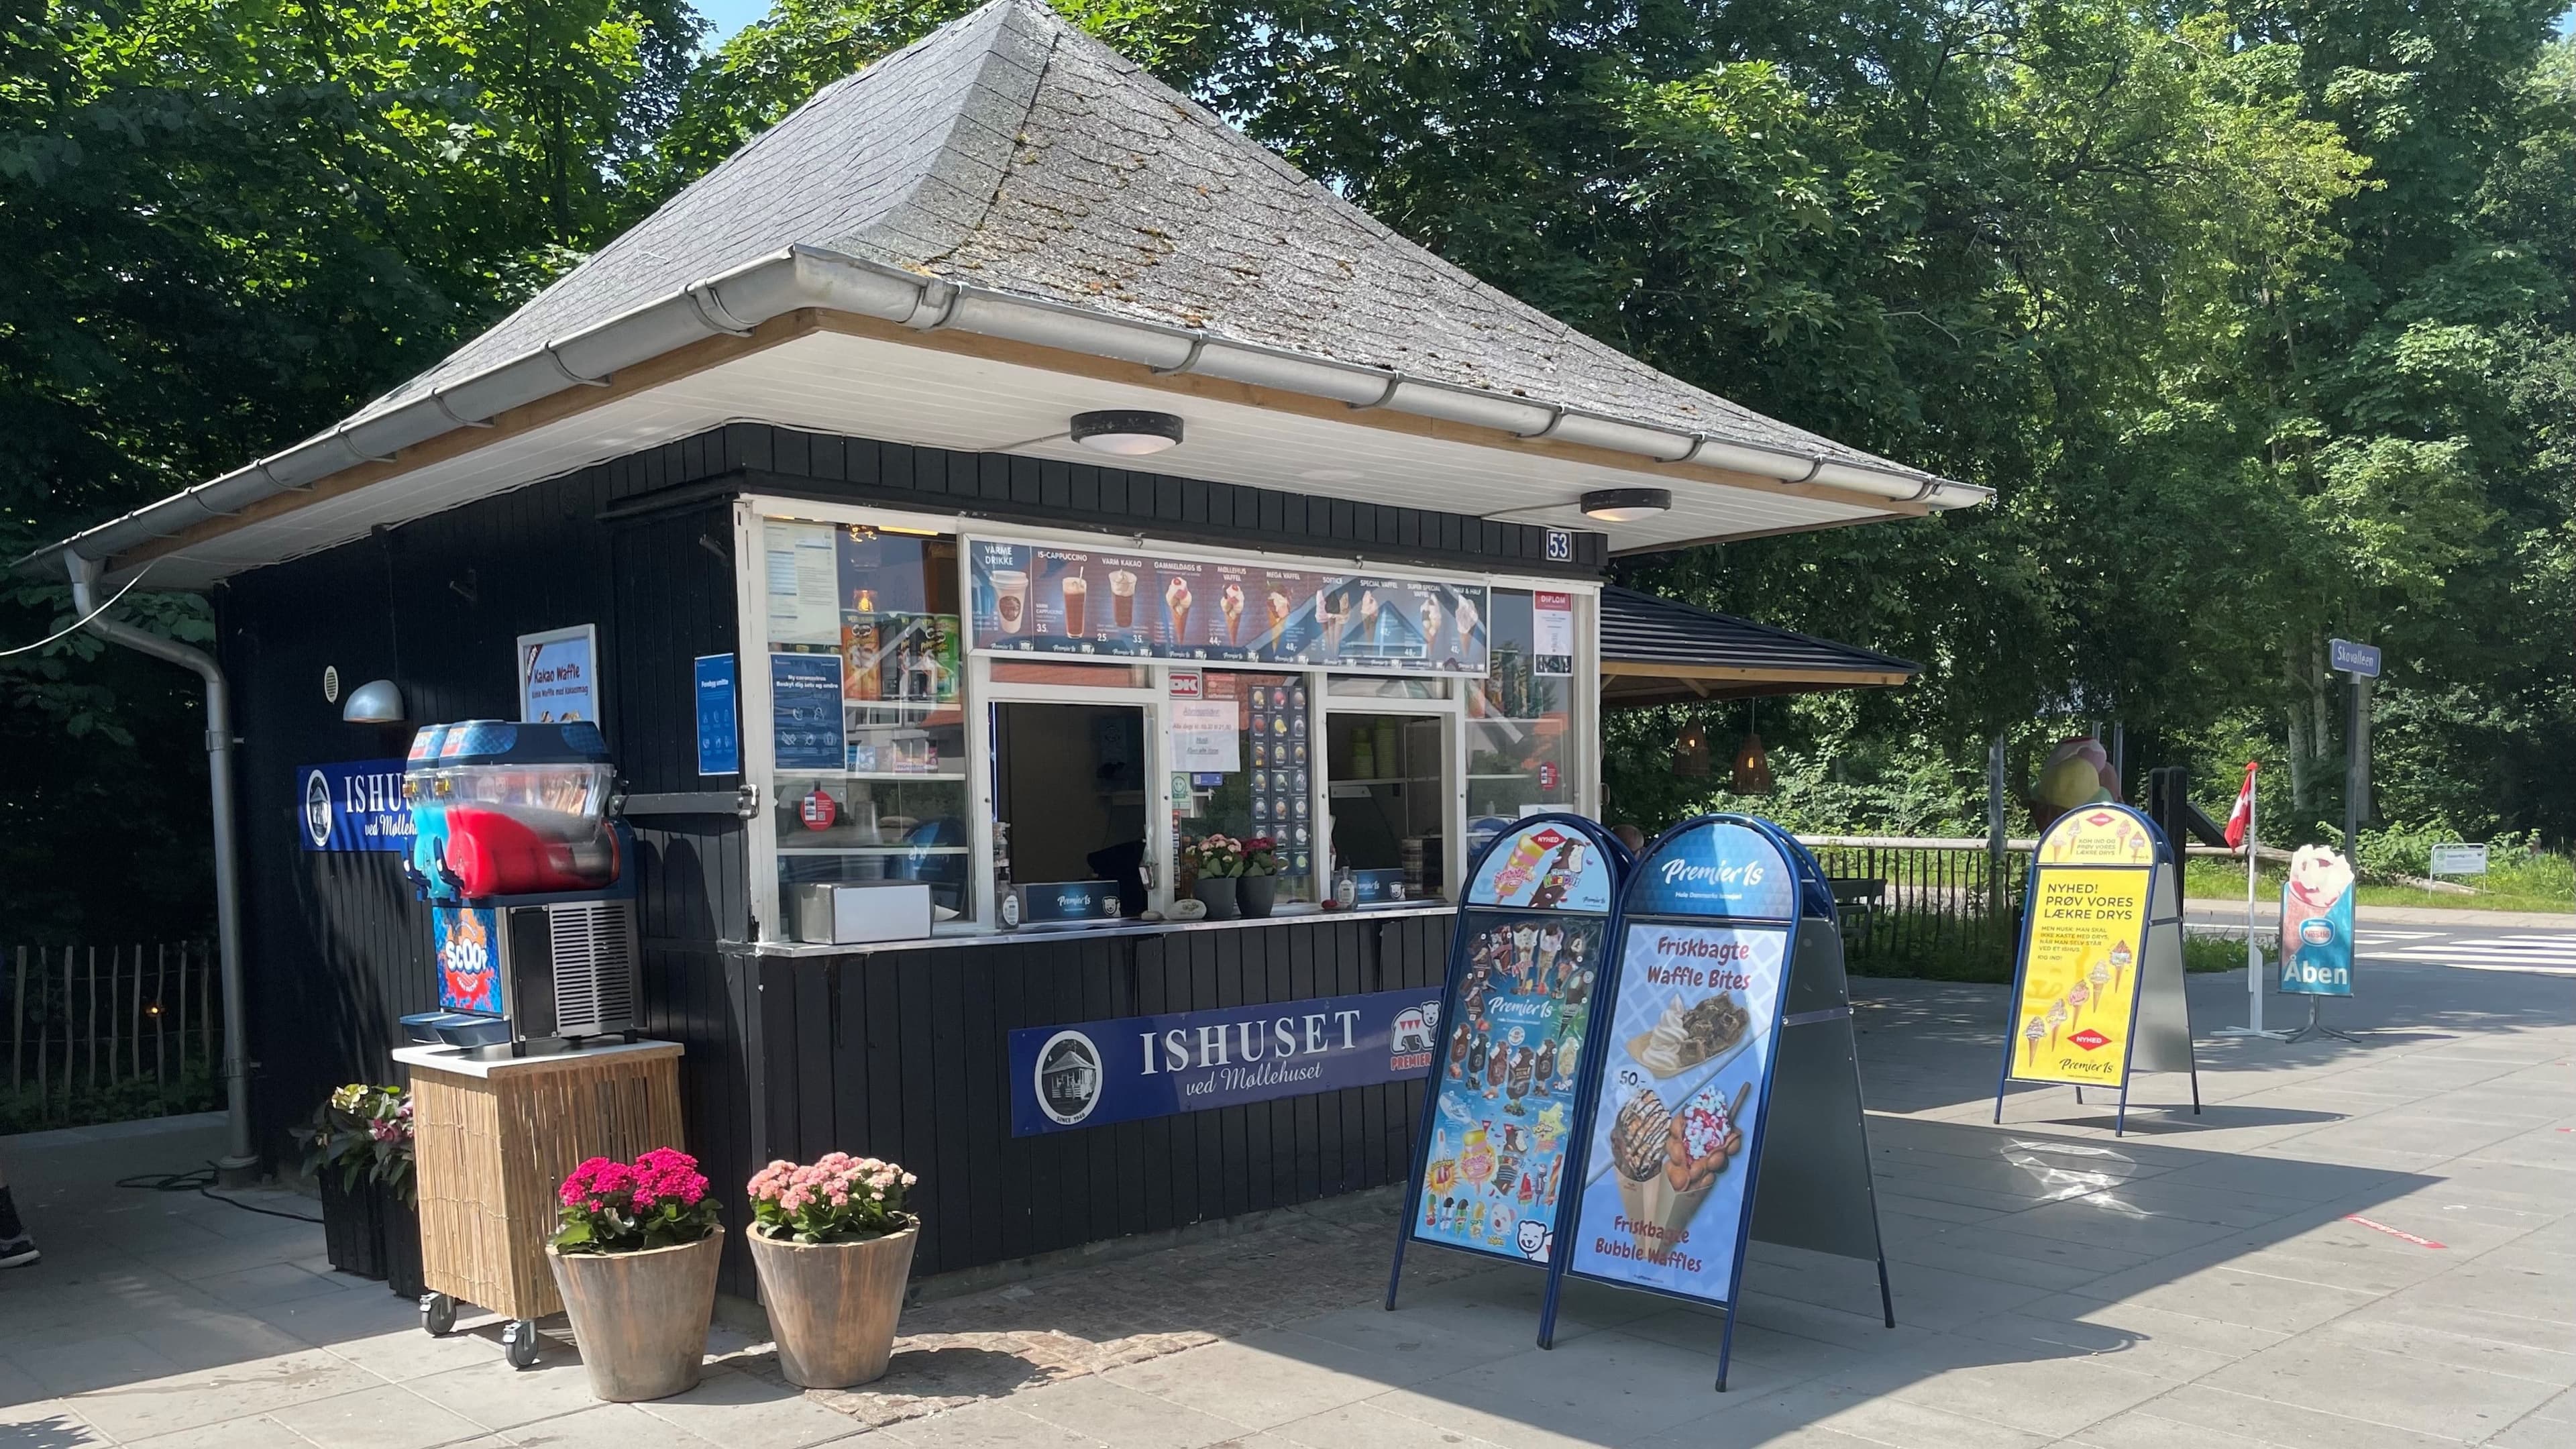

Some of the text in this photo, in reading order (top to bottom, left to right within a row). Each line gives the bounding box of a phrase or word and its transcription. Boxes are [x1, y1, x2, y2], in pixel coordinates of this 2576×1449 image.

[984, 545, 1012, 555] VARME
[1037, 550, 1088, 562] IS-CAPPUCCINO
[1550, 533, 1568, 558] 53
[985, 555, 1013, 566] DRIKKE
[1102, 557, 1142, 568] VARM KAKAO
[1154, 561, 1195, 572] GAMMELDAGS
[1266, 571, 1283, 579] MEGA
[2337, 645, 2373, 667] Skovalleen
[534, 663, 580, 684] Kakao Waffle
[344, 772, 412, 814] ISHU
[364, 812, 418, 838] ved Mølleh
[1538, 836, 1560, 844] NYHED
[1662, 858, 1764, 886] Premier Is
[2047, 883, 2098, 894] NYHED!
[2045, 896, 2133, 907] PRØV VORES
[2044, 909, 2133, 920] LÆKRE DRYS
[1658, 936, 1750, 966] Friskbagte
[1648, 965, 1752, 990] Waffle Bites
[2284, 953, 2348, 985] Åben
[1488, 996, 1554, 1018] Premier Is
[1139, 1010, 1360, 1075] ISHUSET
[1391, 1052, 1432, 1071] PREMIER
[2059, 1058, 2114, 1073] Premier Is
[1186, 1061, 1324, 1097] ved Møllehuset
[1614, 1215, 1690, 1248] Friskbagte
[1595, 1238, 1703, 1273] Bubble Waffles
